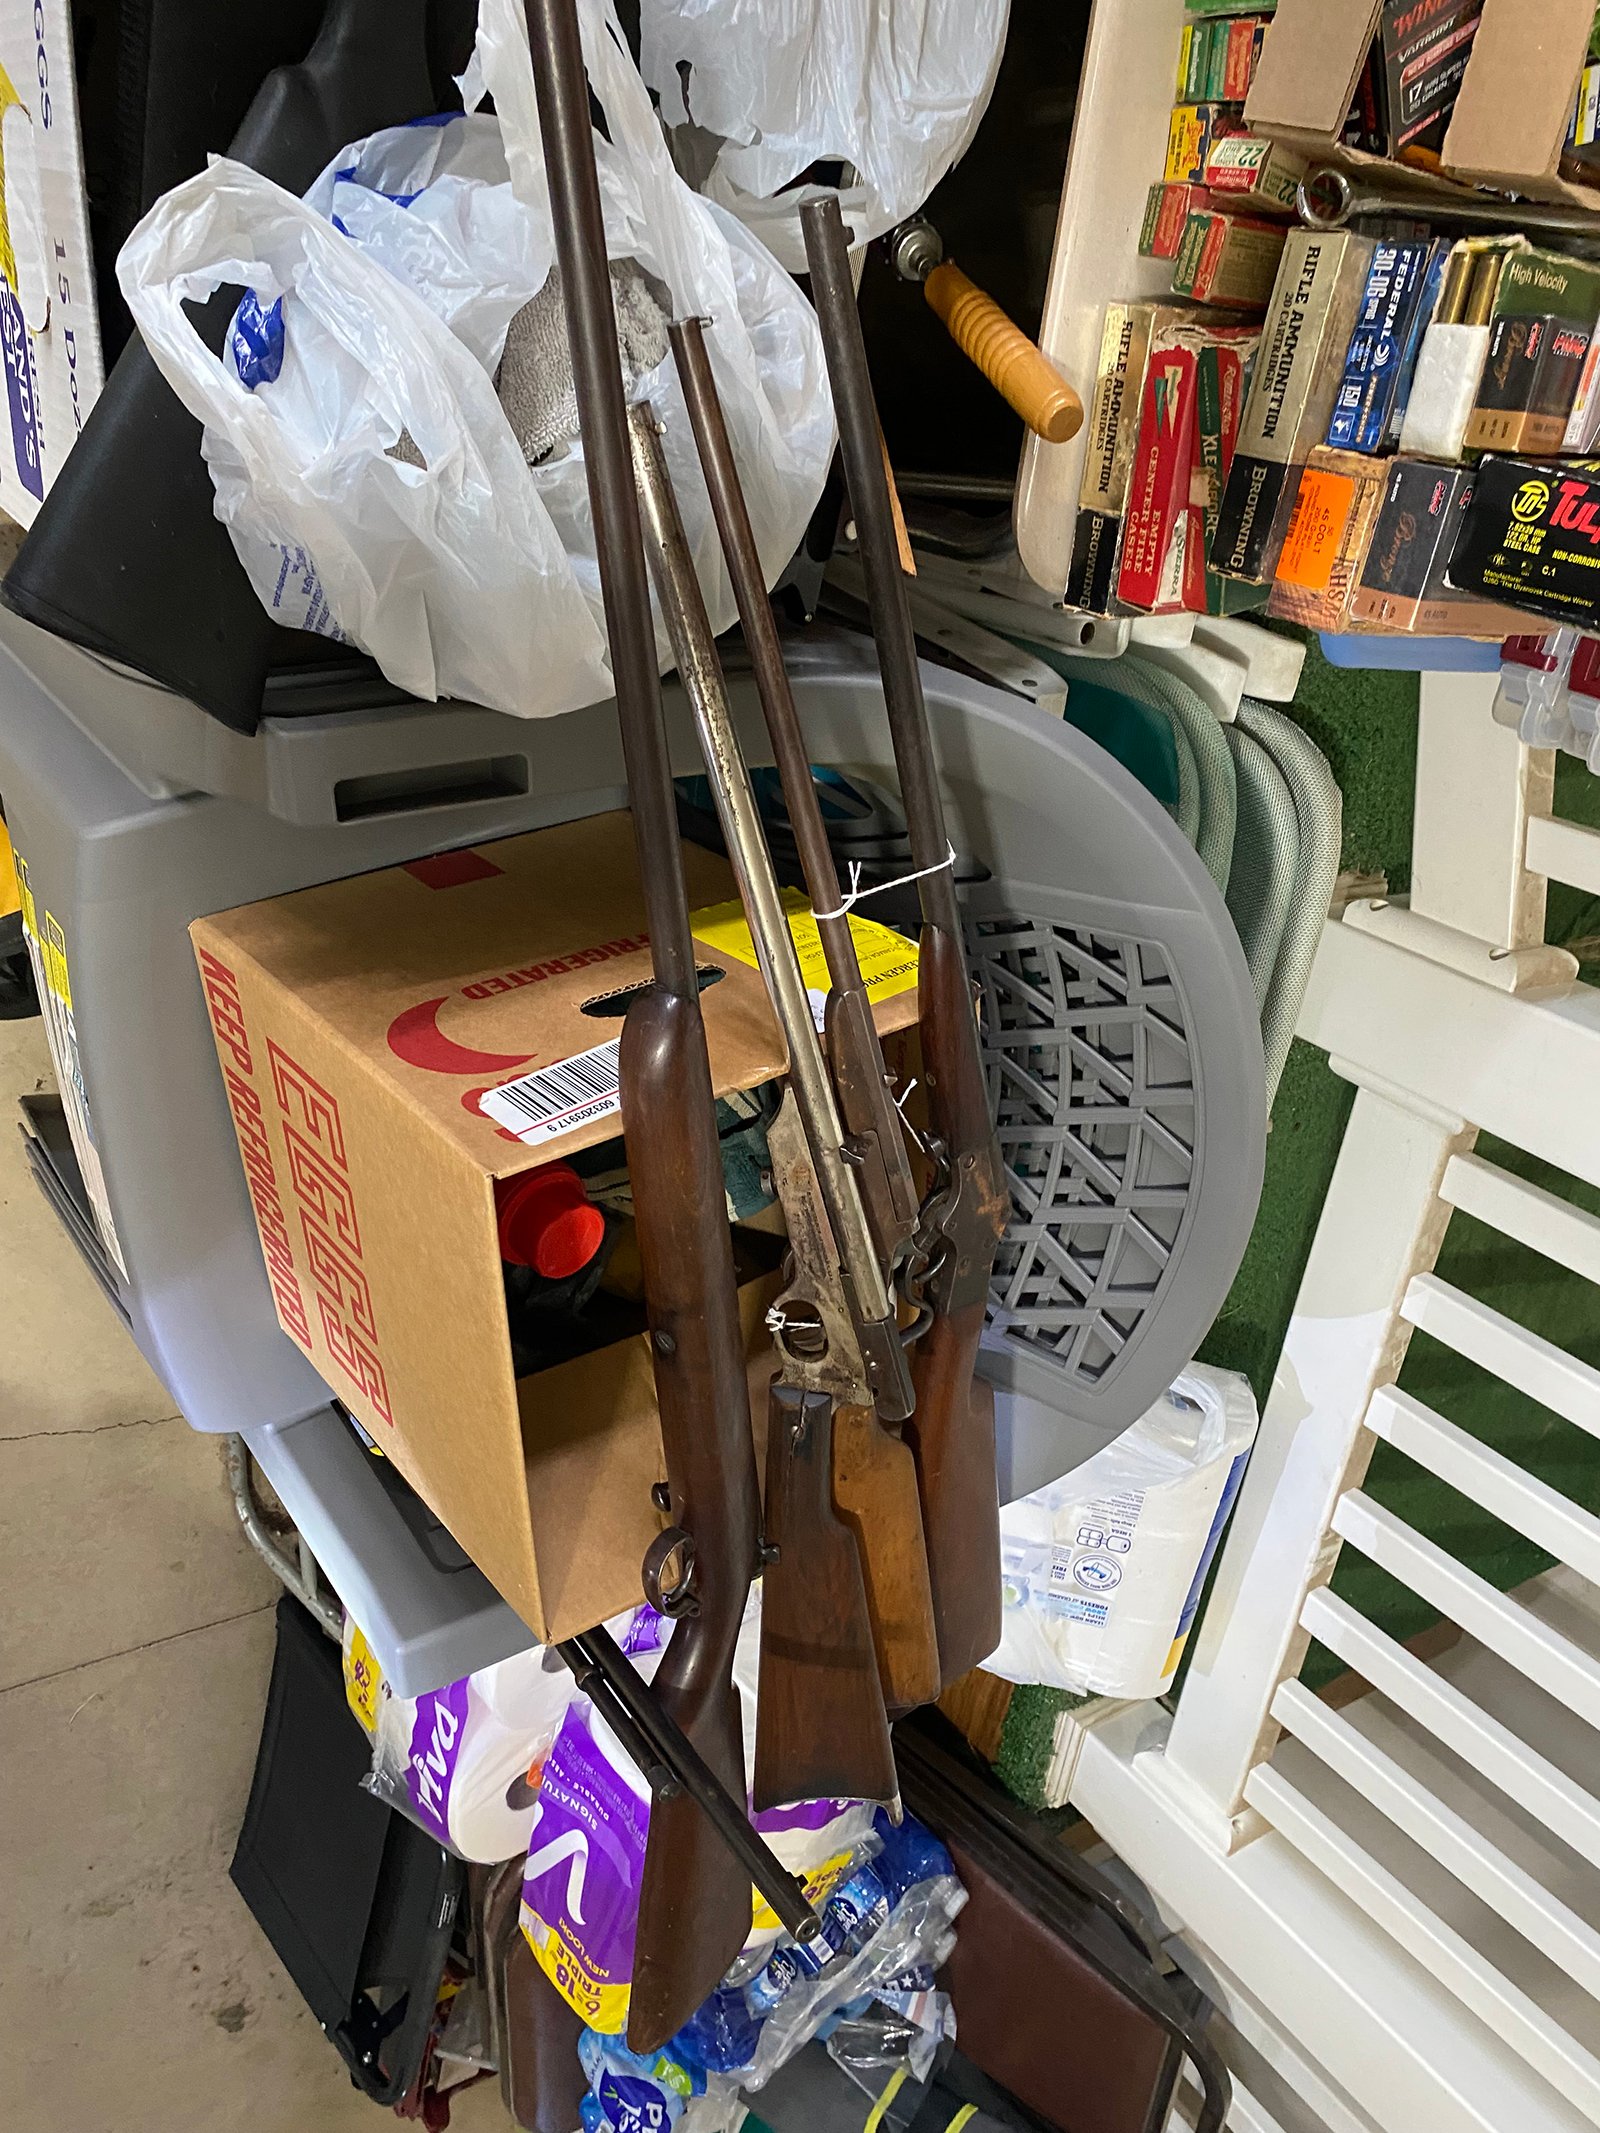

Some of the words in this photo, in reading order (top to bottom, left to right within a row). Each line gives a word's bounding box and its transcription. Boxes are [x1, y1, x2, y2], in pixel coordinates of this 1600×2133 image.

[1408, 80, 1423, 103] 17
[1238, 147, 1264, 167] 22
[53, 237, 70, 305] 15
[1283, 291, 1295, 310] 20
[1294, 246, 1321, 303] RIFLE
[1367, 248, 1397, 298] 30-06
[1380, 251, 1413, 341] FEDERAL
[1509, 262, 1532, 285] High
[1534, 268, 1569, 295] Velocity
[1115, 321, 1133, 373] RIFLE
[1262, 312, 1288, 391] CARTRIDGES
[1262, 307, 1306, 438] AMMUNITION
[1552, 329, 1590, 360] PMC
[9, 308, 37, 469] AND'S
[1097, 377, 1113, 451] CARTRIDGES
[1342, 385, 1362, 408] 150
[1098, 378, 1125, 494] AMMUNITION
[1142, 446, 1160, 525] CENTER
[1124, 511, 1139, 570] CASES
[1143, 510, 1162, 577] EMPTY
[1231, 465, 1268, 569] BROWNING
[1313, 523, 1328, 555] COLT
[1078, 515, 1105, 609] BROWNING
[1133, 526, 1148, 573] FIRE
[1170, 535, 1185, 597] SIERRA
[1503, 540, 1523, 551] STEEL
[1523, 542, 1542, 555] CASE
[1552, 549, 1600, 570] NON-CORROSIV
[461, 933, 650, 1000] FRIGERATED
[201, 949, 254, 1074] KEEP
[225, 1065, 312, 1350] REFRIGERATED
[266, 1036, 394, 1427] EGGS
[555, 1941, 604, 1998] TRIPLE
[583, 1957, 610, 1978] NEW
